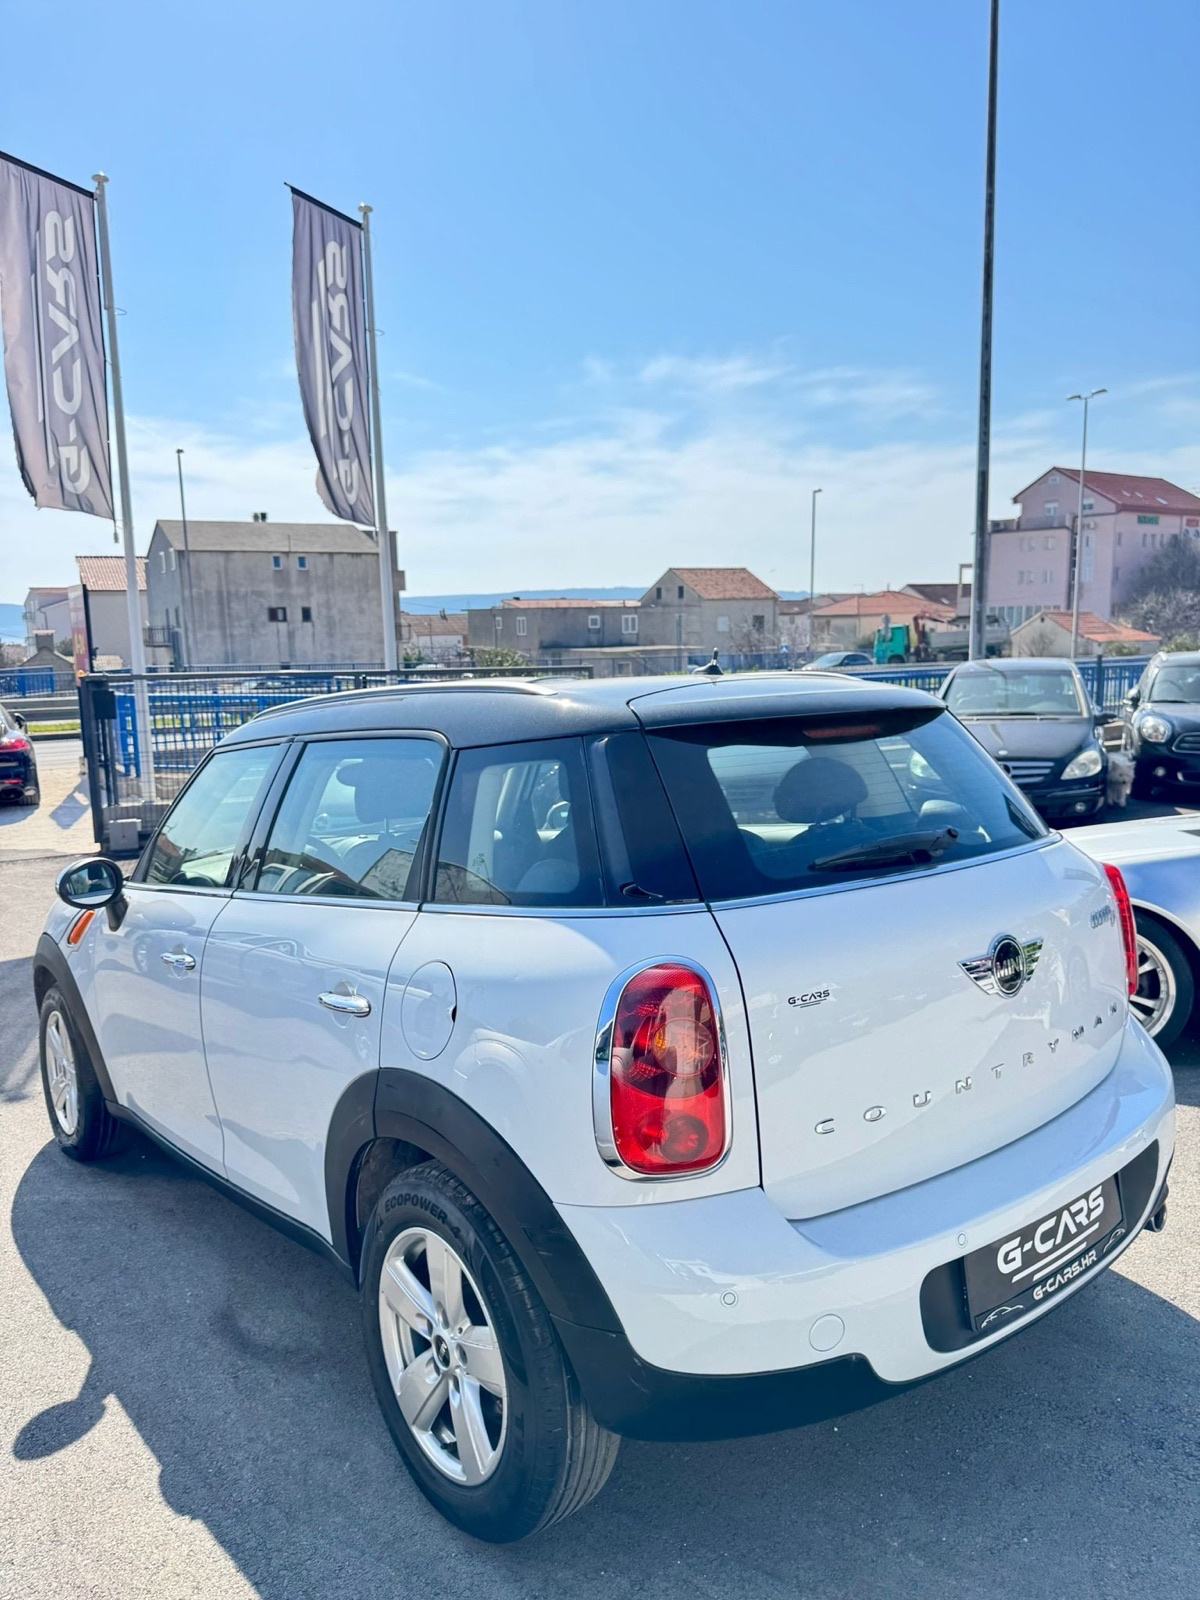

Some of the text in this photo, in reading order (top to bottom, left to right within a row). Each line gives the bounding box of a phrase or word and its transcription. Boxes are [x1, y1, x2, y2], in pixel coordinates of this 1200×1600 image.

[996, 953, 1024, 979] MINI
[787, 989, 831, 1005] G-CARS
[814, 1001, 1119, 1136] COUNTRYMAN
[384, 1192, 448, 1224] ECOPOWER
[997, 1185, 1105, 1275] G-CARS
[1032, 1249, 1097, 1301] G-CARS.HR
